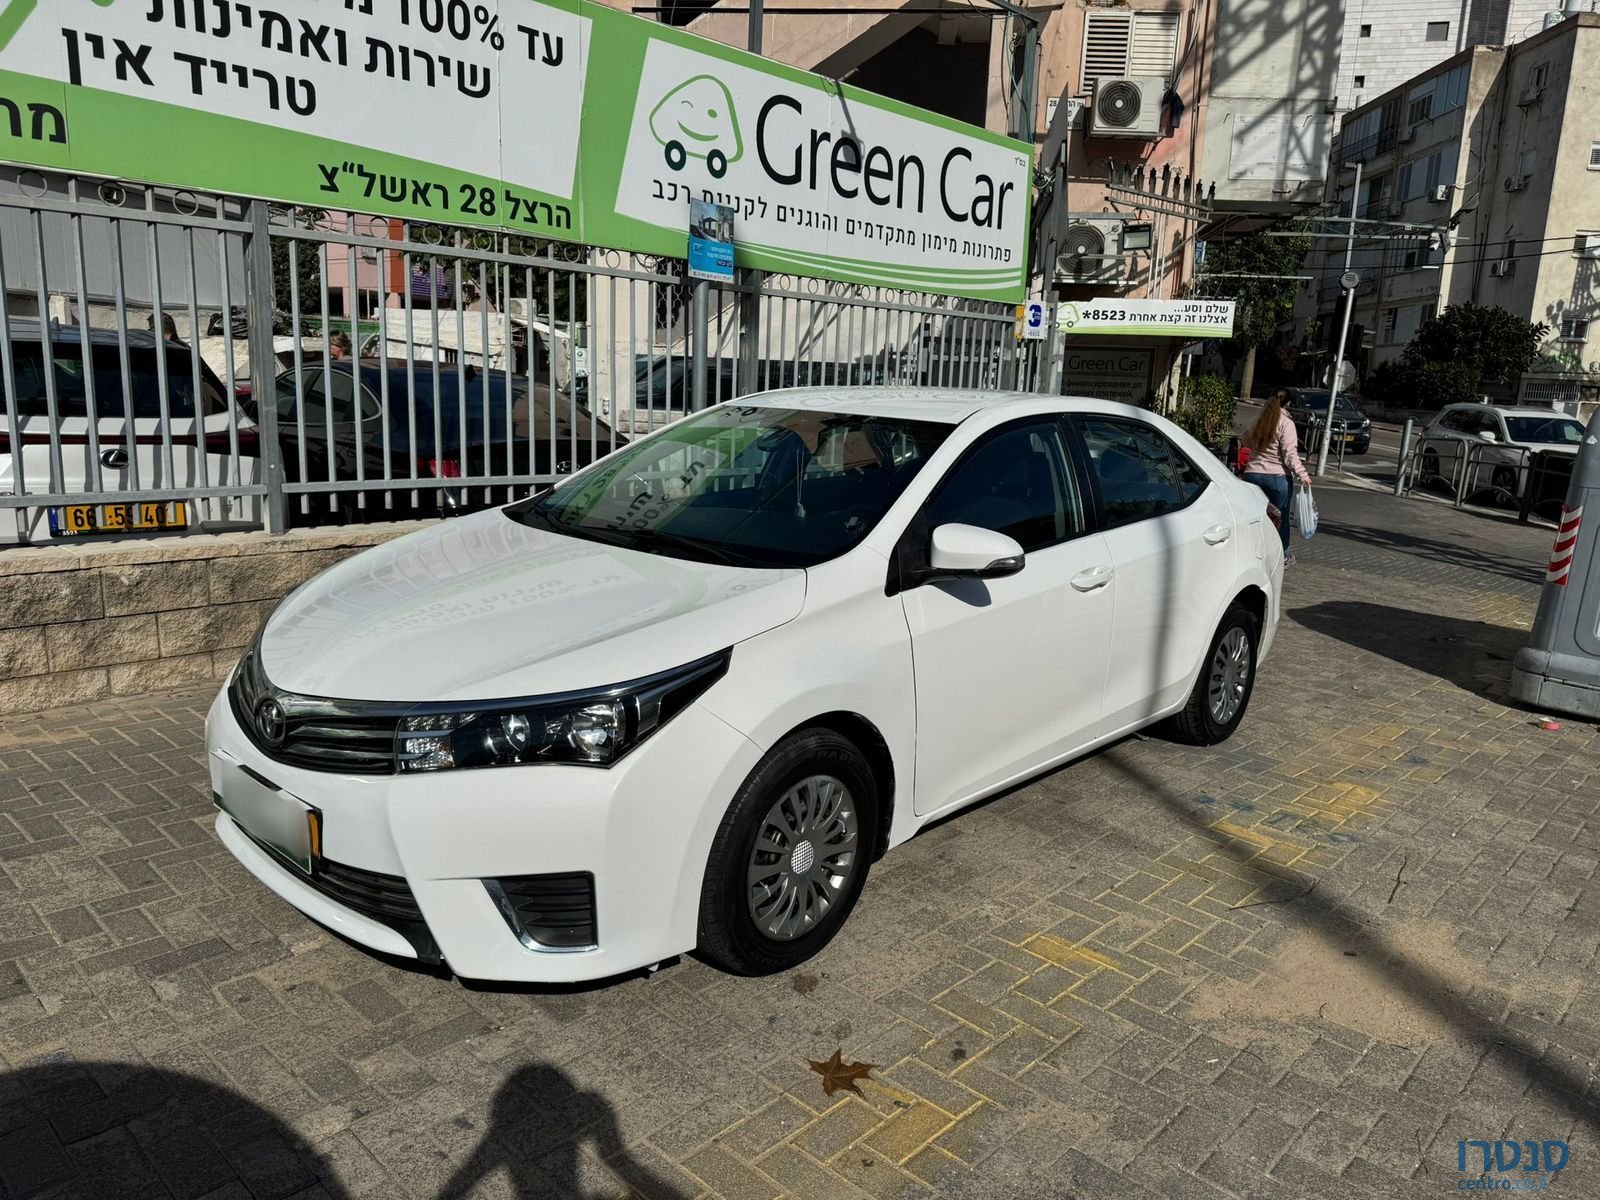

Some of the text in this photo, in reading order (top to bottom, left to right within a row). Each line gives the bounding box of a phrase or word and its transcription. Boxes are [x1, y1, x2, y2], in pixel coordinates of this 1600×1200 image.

[400, 0, 564, 67] עד 100%
[146, 0, 491, 98] שירות ואמינות
[61, 27, 317, 116] טרייד אין
[756, 94, 1014, 230] Green Car
[459, 184, 496, 216] 28
[653, 180, 691, 204] רכב
[505, 190, 572, 229] הרצל
[777, 204, 838, 231] והוגנים
[846, 218, 915, 246] מתקדמים
[922, 232, 957, 252] מימון
[962, 241, 1012, 262] פתרונות
[1129, 313, 1228, 324] אצלנו זה קצת אחרת
[1205, 304, 1229, 313] שלם
[1068, 355, 1145, 371] Green Car
